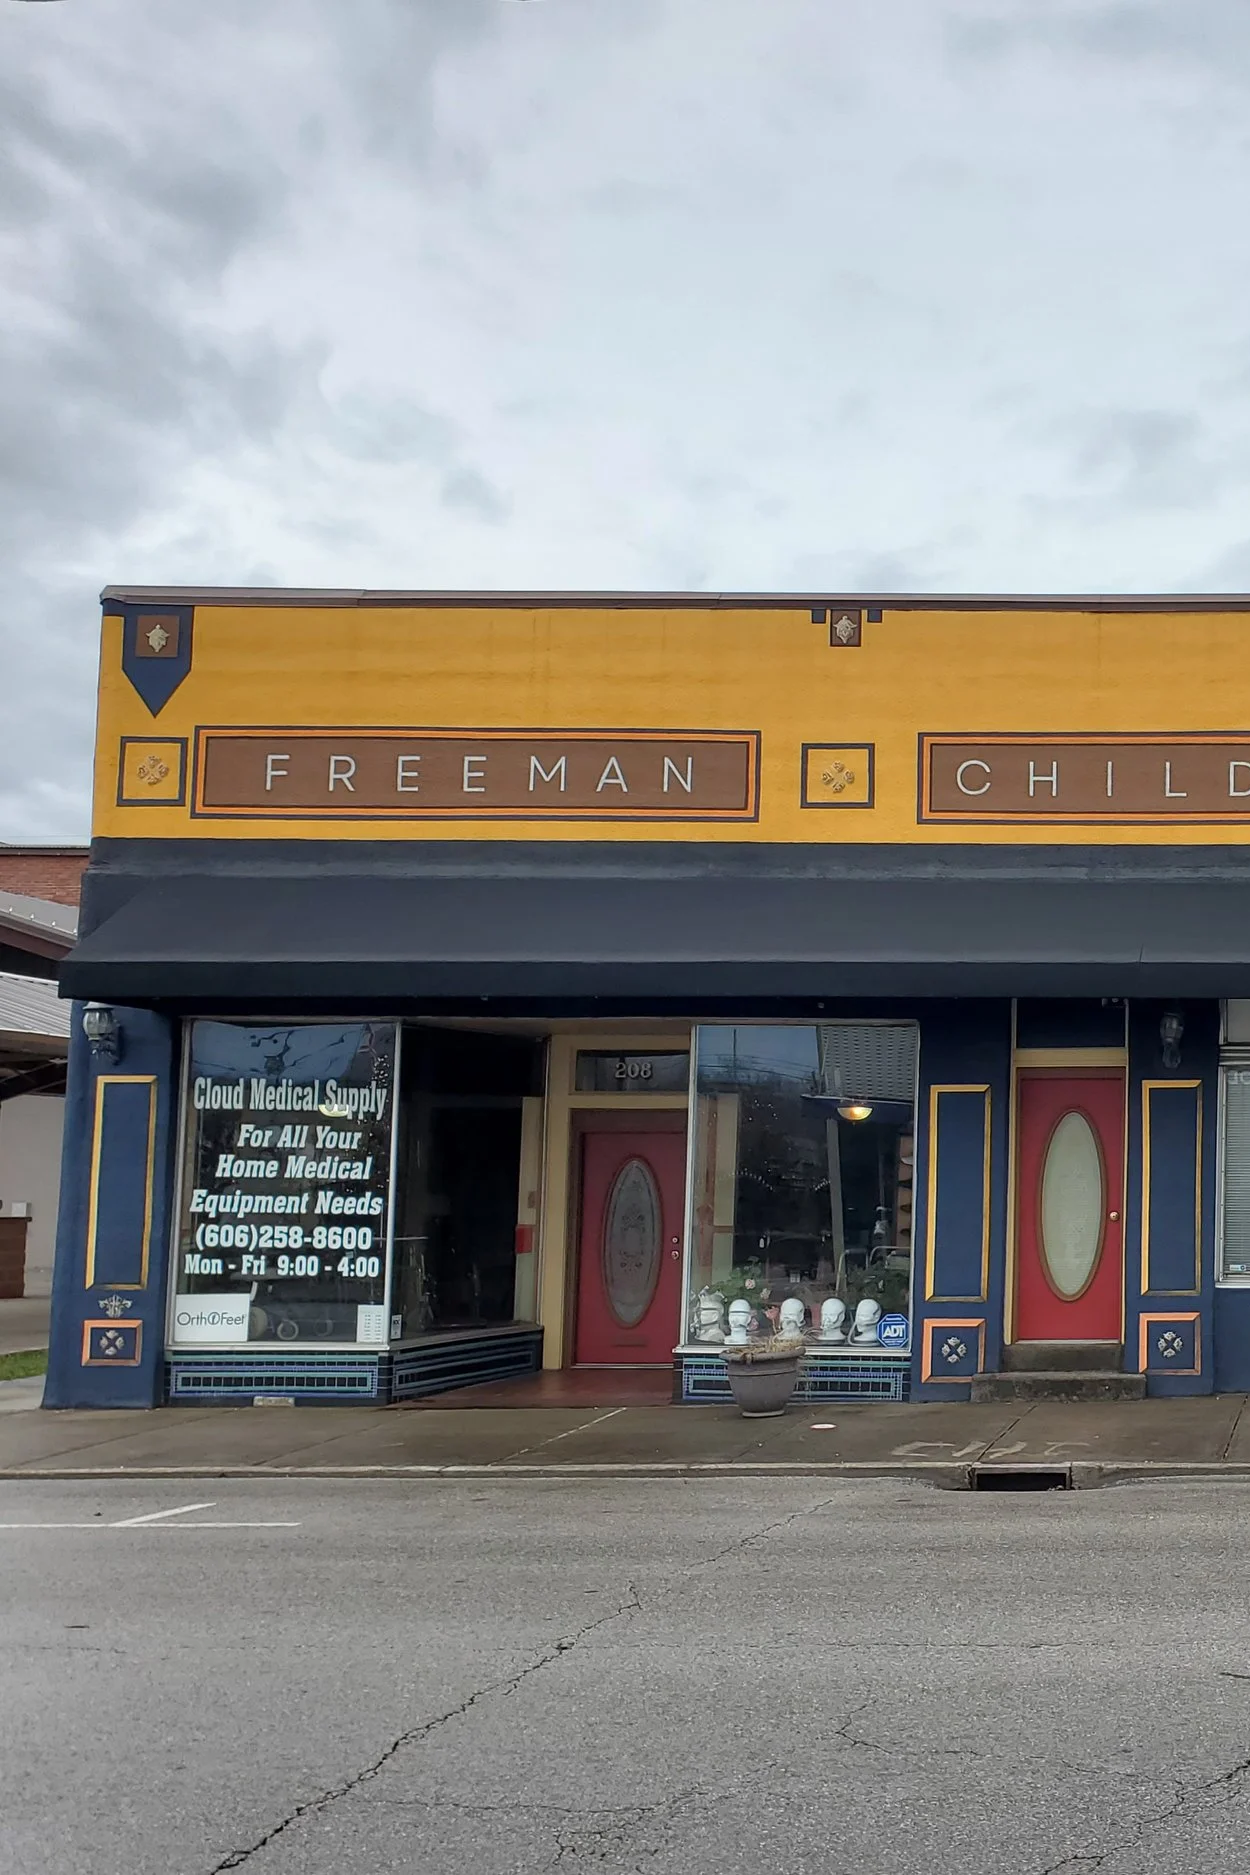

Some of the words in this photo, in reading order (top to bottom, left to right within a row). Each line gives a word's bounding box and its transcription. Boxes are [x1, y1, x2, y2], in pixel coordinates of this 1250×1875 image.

[264, 753, 693, 793] FREEMAN
[615, 1062, 651, 1078] 208
[193, 1076, 244, 1110] Cloud
[250, 1077, 319, 1111] Medical
[325, 1079, 388, 1121] Supply
[237, 1123, 273, 1147] For
[277, 1124, 309, 1148] All
[315, 1125, 362, 1149] Your
[215, 1154, 279, 1178] Home
[284, 1155, 373, 1180] Medical
[189, 1189, 310, 1219] Equipment
[314, 1190, 383, 1215] Needs
[195, 1223, 372, 1251] (606)258-8600
[184, 1253, 223, 1274] Mon
[241, 1254, 266, 1275] Fri
[277, 1255, 319, 1276] 9:00
[337, 1256, 379, 1277] 4:00
[883, 1325, 906, 1337] ADT
